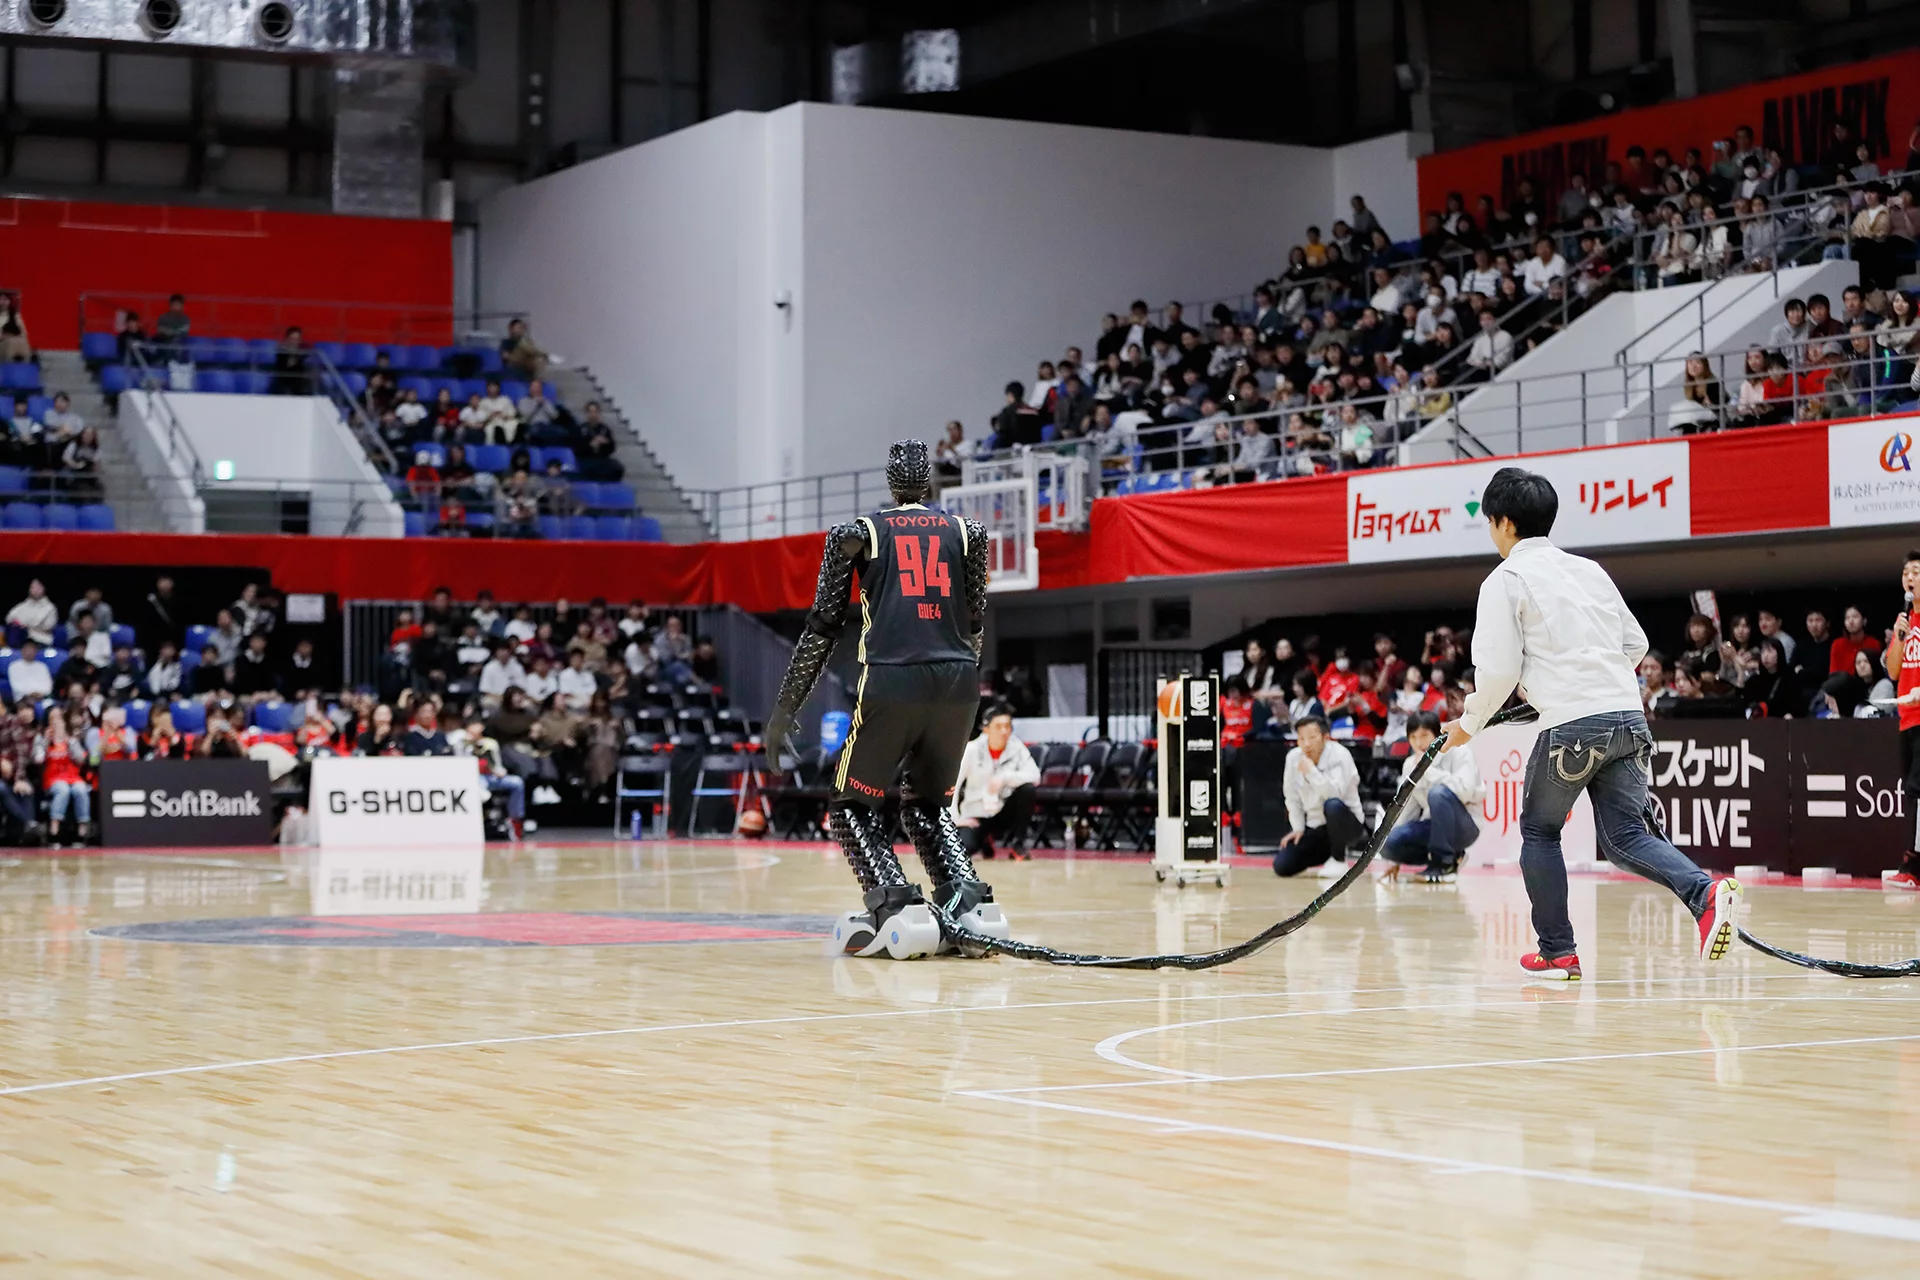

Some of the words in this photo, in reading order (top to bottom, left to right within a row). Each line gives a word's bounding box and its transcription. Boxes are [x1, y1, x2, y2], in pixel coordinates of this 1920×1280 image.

[1580, 476, 1673, 514] リンレイ
[885, 515, 950, 528] TOYOTA
[1353, 492, 1451, 542] トヨタイムズ
[894, 535, 951, 597] 94
[917, 603, 942, 620] CUE4
[150, 789, 262, 818] SoftBank
[329, 789, 469, 814] G-SHOCK
[849, 777, 885, 798] TOYOTA
[1856, 774, 1906, 818] Sof
[1671, 798, 1751, 848] LIVE
